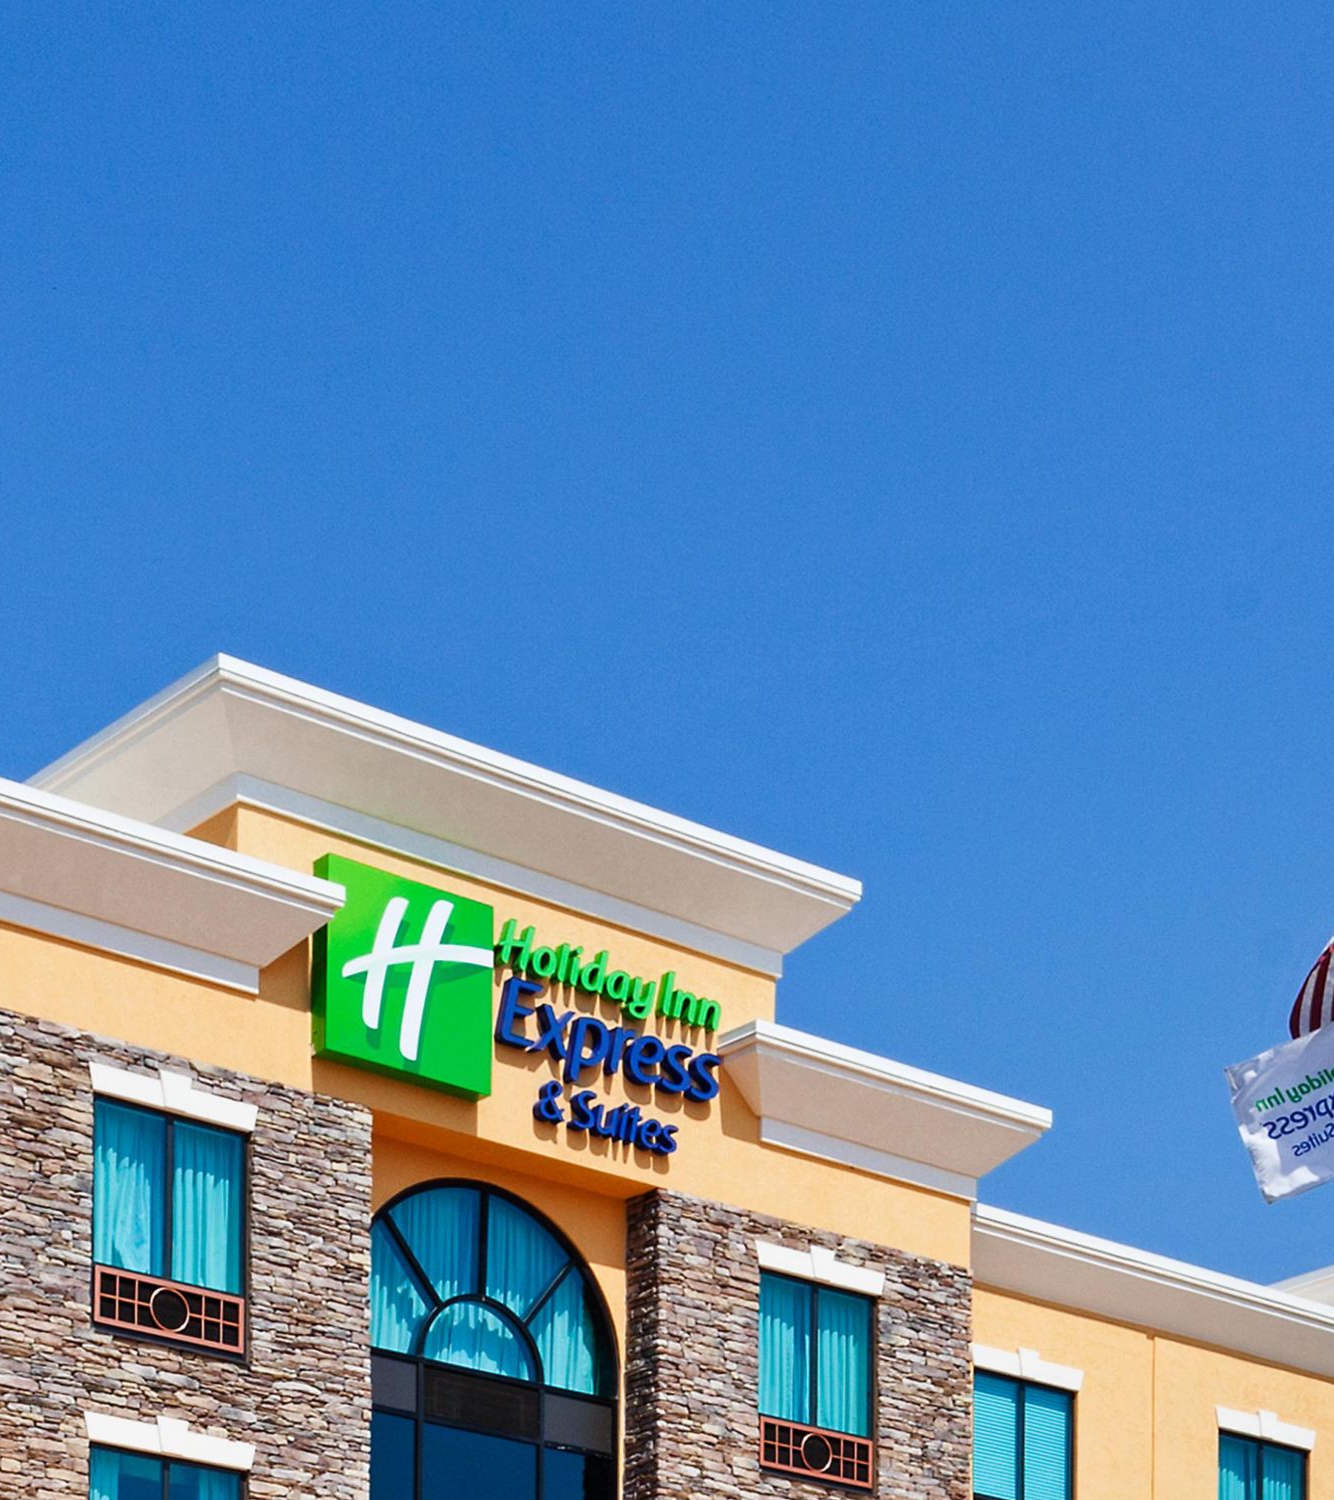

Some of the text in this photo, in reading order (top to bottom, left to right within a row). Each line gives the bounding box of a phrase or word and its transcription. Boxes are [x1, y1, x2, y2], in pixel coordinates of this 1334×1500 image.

[494, 918, 721, 1032] Holiday Inn
[495, 976, 722, 1103] Express
[533, 1080, 679, 1154] & Suites
